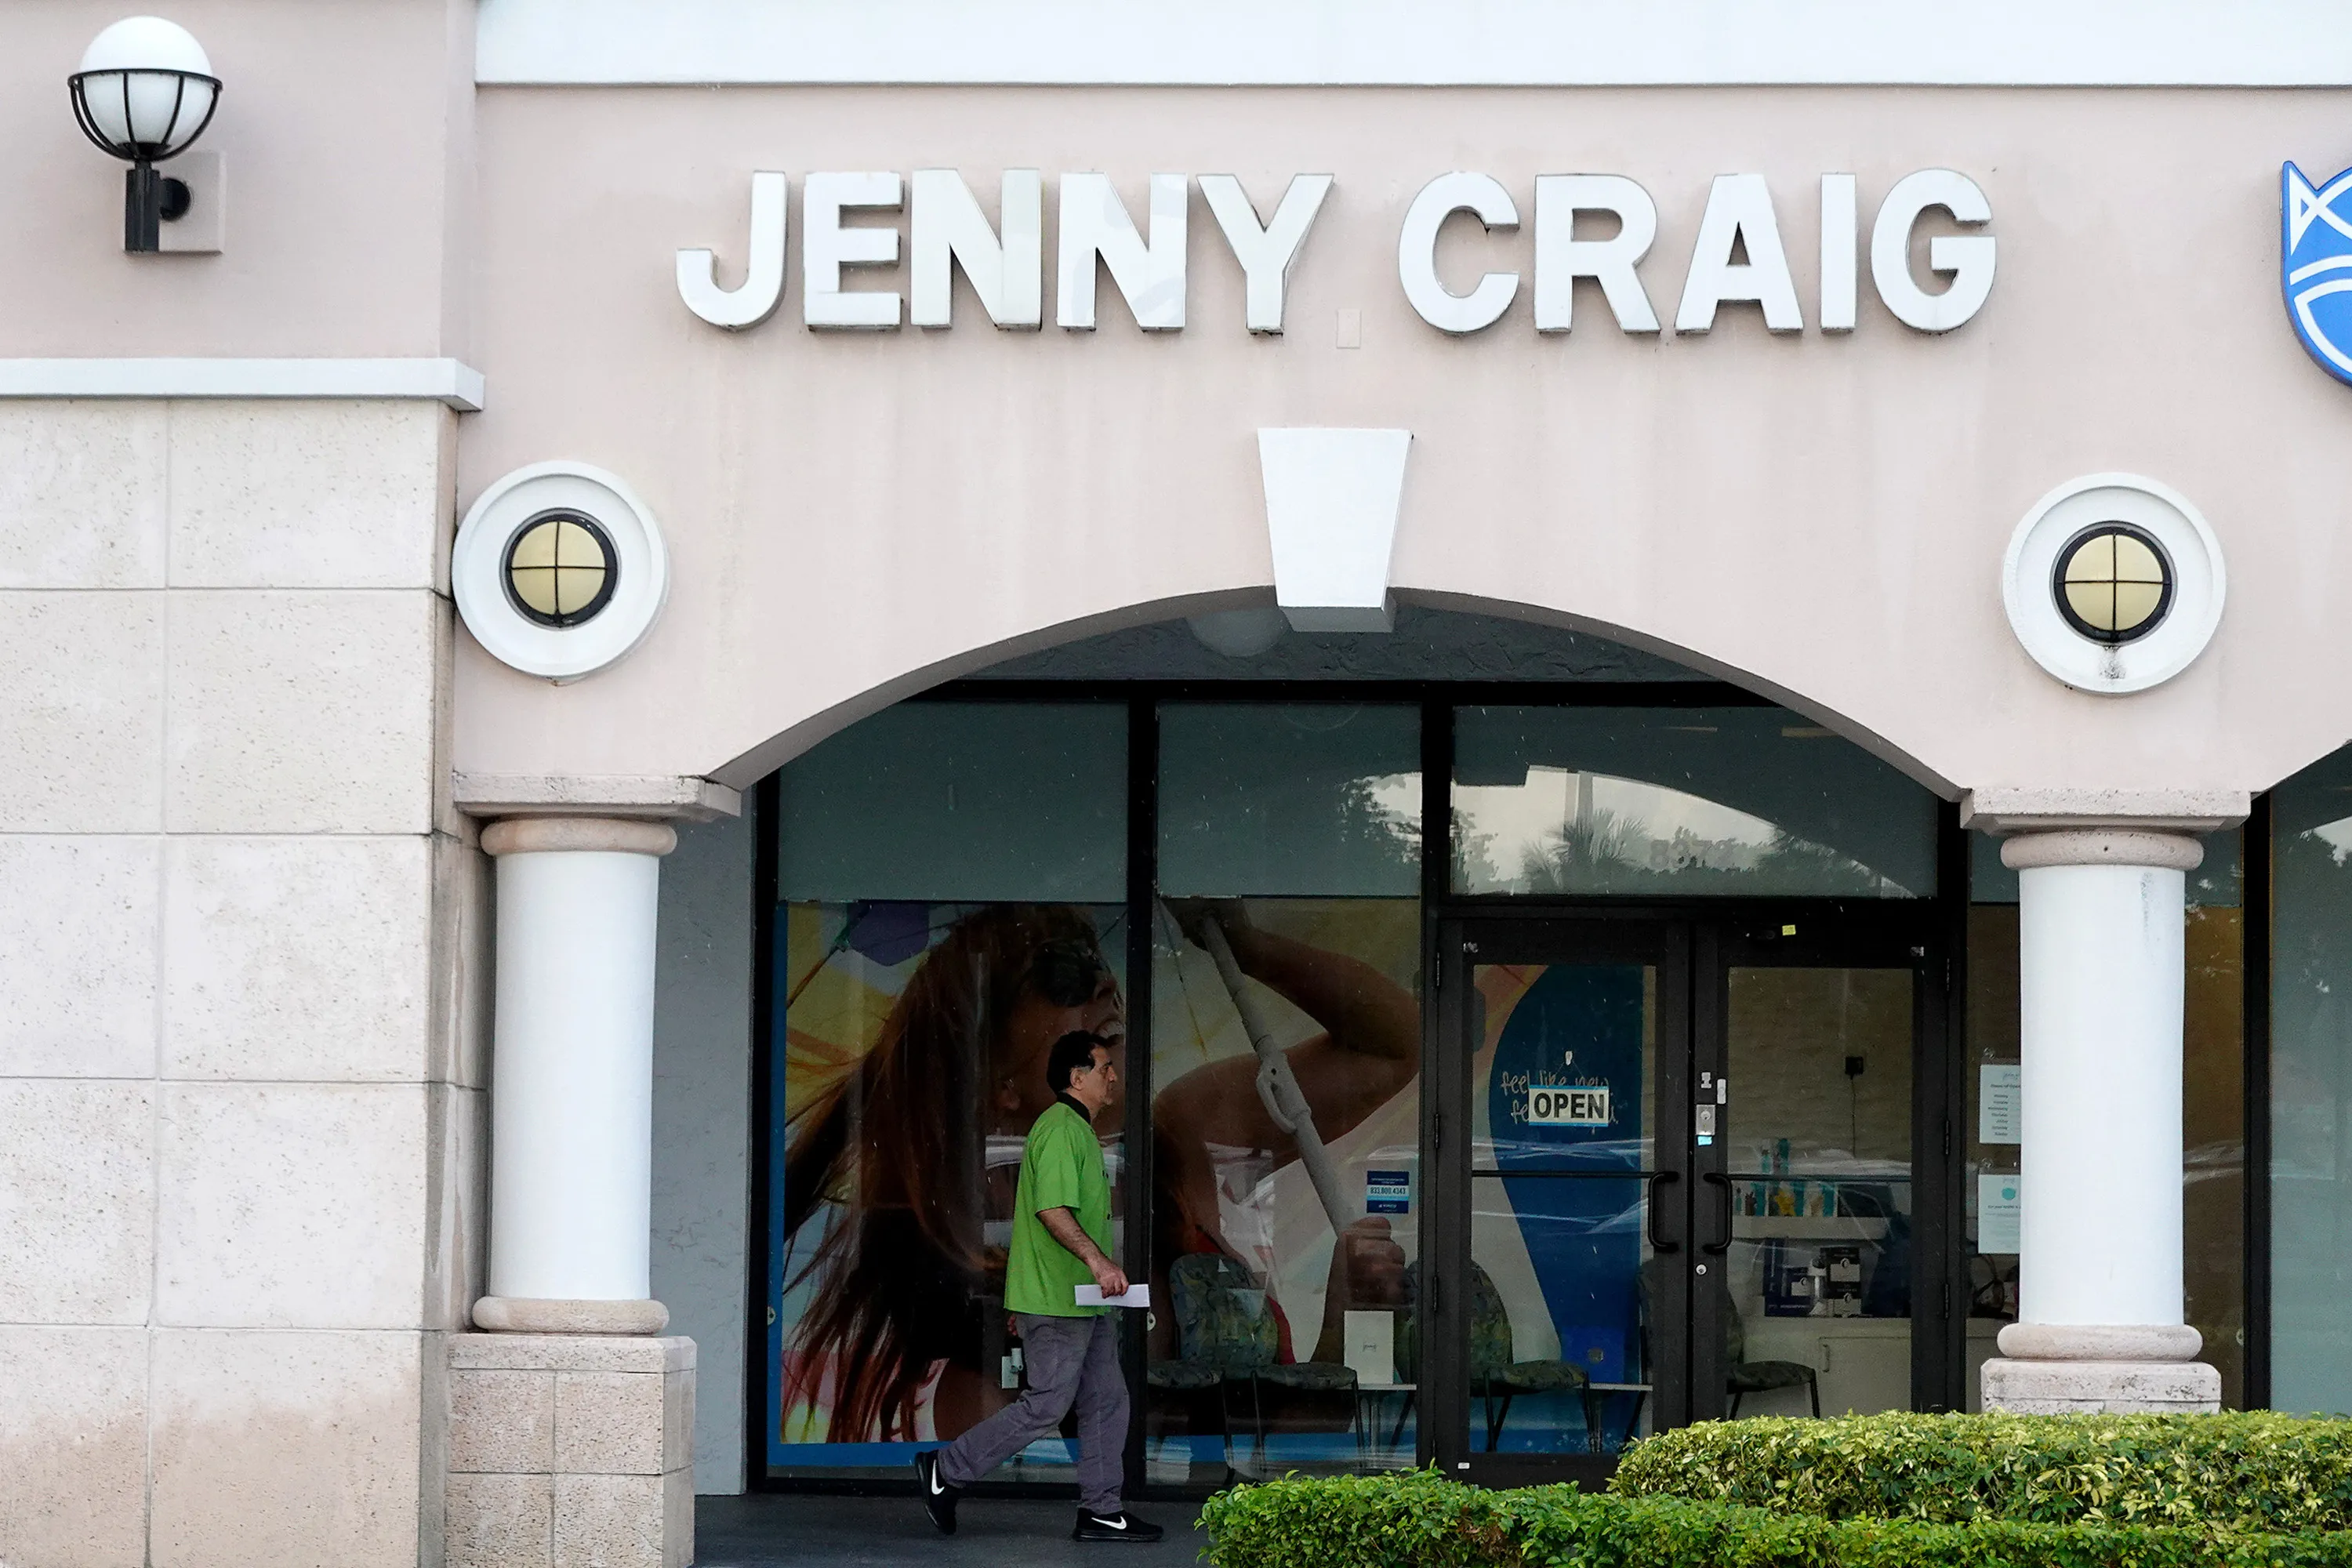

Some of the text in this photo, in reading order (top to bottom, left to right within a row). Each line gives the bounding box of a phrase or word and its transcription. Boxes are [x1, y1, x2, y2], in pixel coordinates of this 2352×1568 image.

[675, 168, 1997, 334] JENNY CRAIG
[1501, 1069, 1530, 1096] feel
[1534, 1092, 1605, 1119] OPEN
